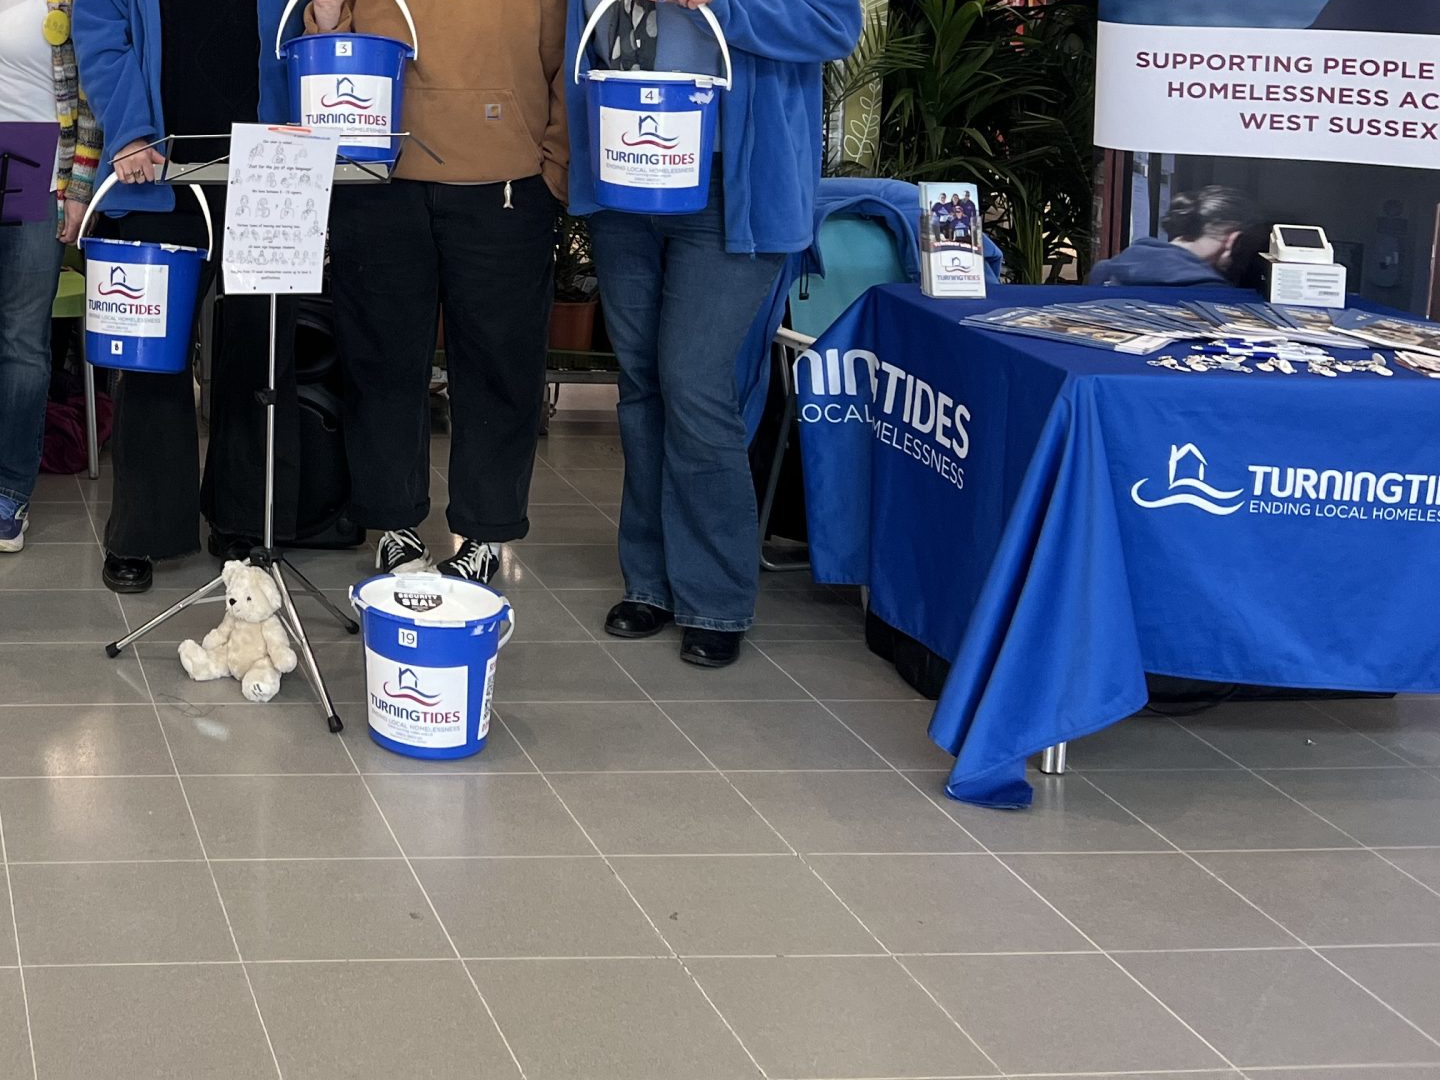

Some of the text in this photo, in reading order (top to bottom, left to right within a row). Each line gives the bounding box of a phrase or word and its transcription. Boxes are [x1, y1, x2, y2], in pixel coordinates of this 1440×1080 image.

[340, 44, 347, 54] 3
[1136, 51, 1435, 80] SUPPORTING PEOPLE
[645, 90, 654, 100] 4
[1167, 81, 1440, 111] HOMELESSNESS AC
[306, 113, 387, 126] TURNINGTIDES
[1239, 112, 1439, 140] WEST SUSSEX
[605, 149, 695, 166] TURNINGTIDES
[88, 299, 161, 316] TURNINGTIDES
[797, 403, 874, 423] OCAL
[1248, 465, 1440, 506] TURNINGTI
[1250, 500, 1310, 516] ENDING
[1315, 504, 1367, 520] LOCAL
[402, 598, 436, 607] SEAL
[401, 631, 415, 644] 19
[371, 693, 460, 724] TURNINGTIDES
